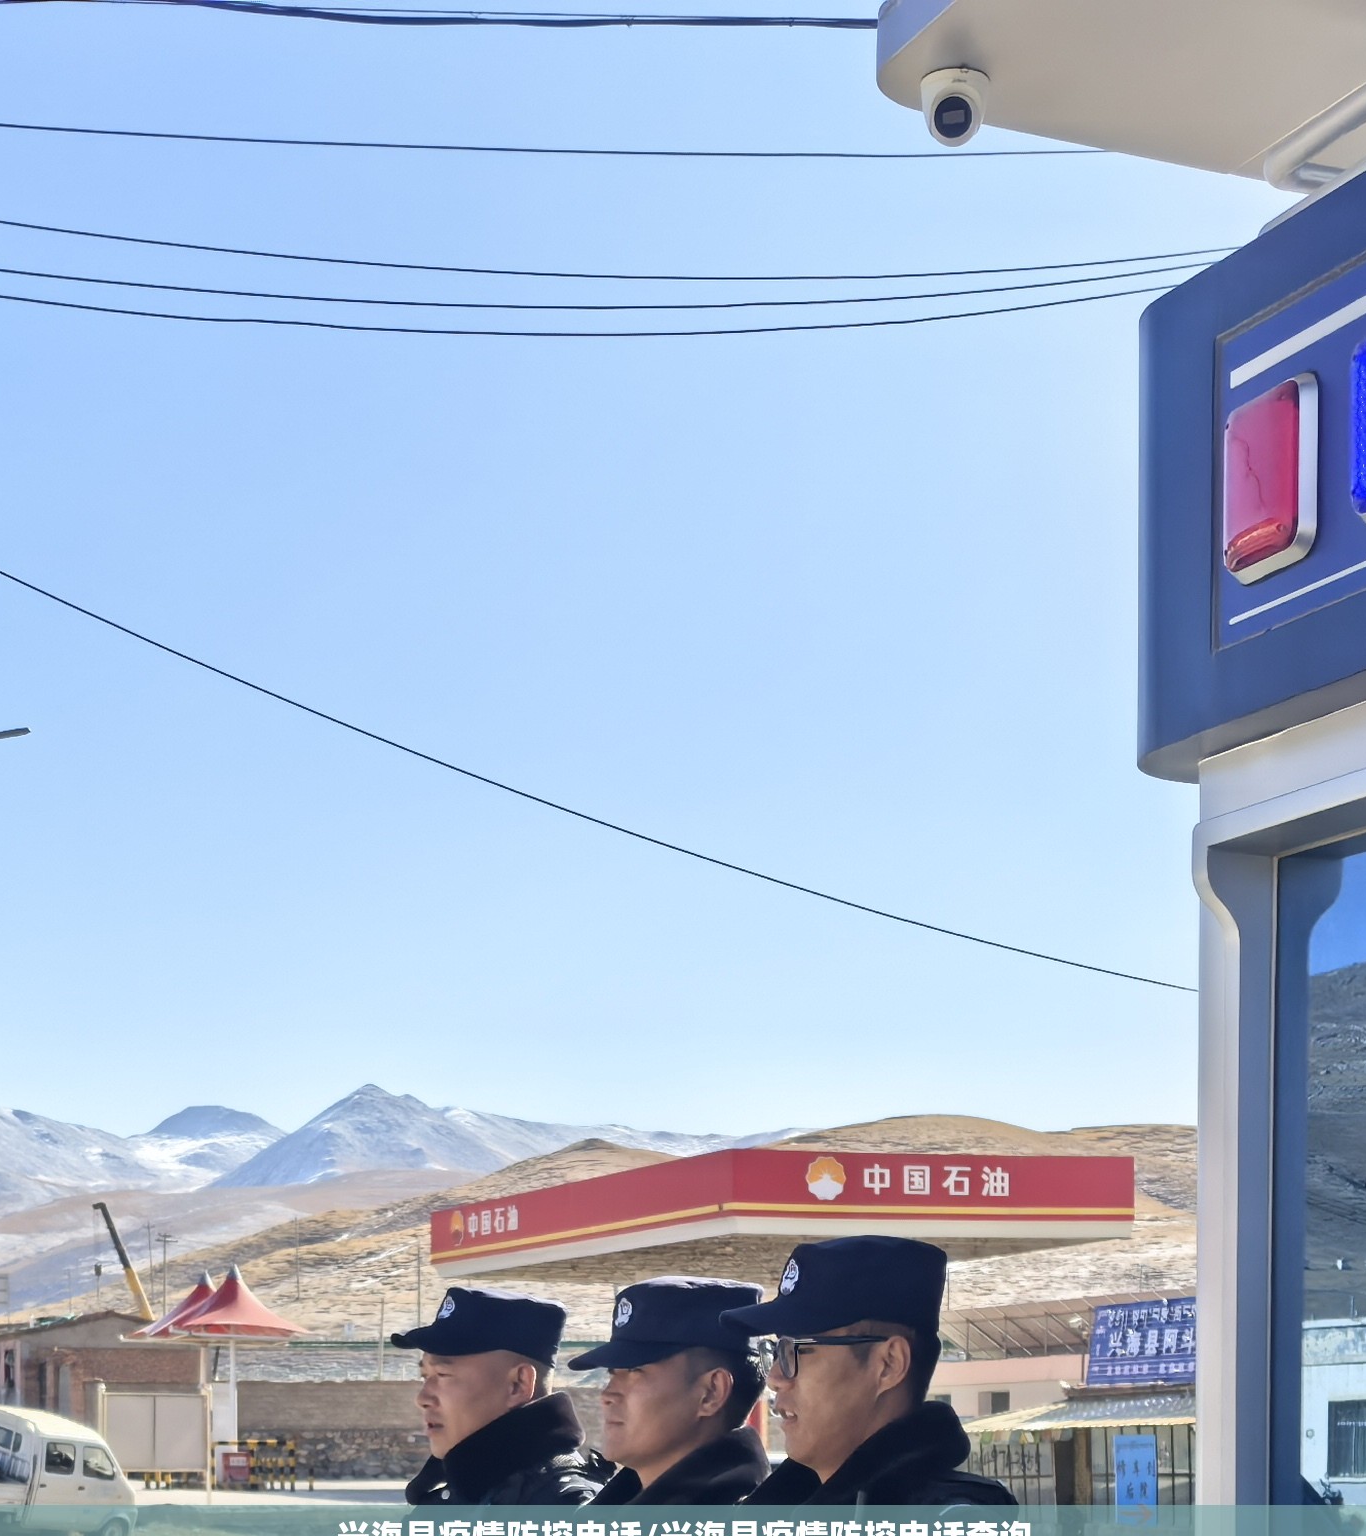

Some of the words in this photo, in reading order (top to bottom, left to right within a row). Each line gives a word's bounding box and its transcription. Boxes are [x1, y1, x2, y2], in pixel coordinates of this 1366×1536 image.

[863, 1163, 1010, 1197] 中国石油
[468, 1205, 518, 1238] 中国石油
